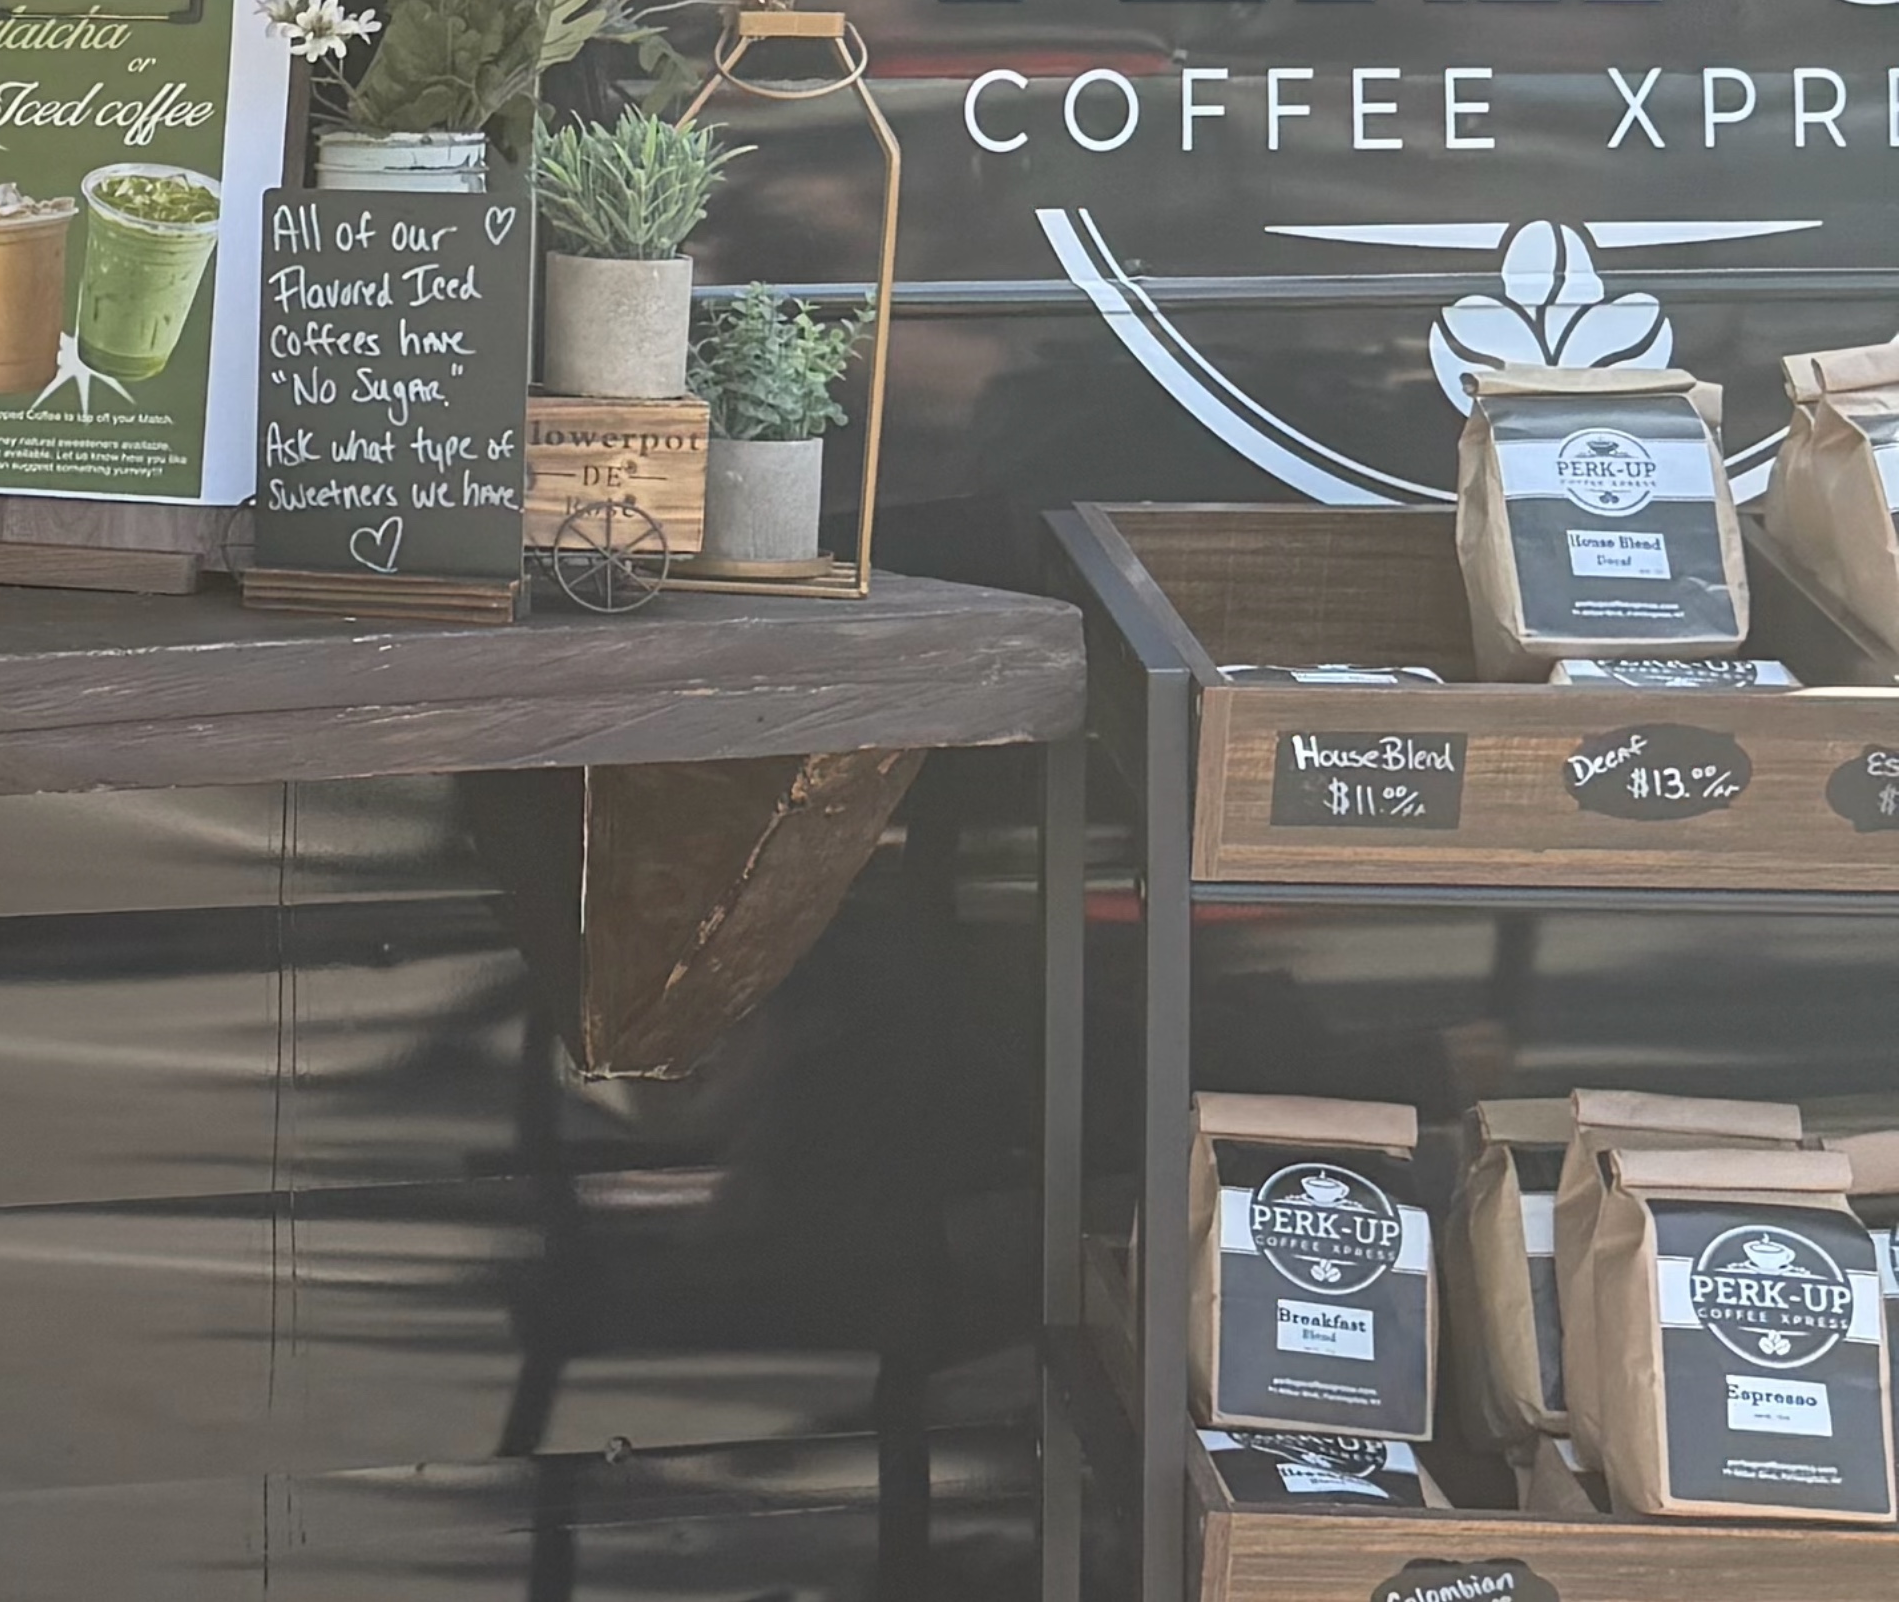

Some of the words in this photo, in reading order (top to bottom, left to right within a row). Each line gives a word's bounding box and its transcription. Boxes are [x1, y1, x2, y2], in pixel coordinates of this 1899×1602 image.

[128, 55, 157, 73] or
[96, 82, 215, 146] coffee
[963, 67, 1496, 152] COFFEE
[1606, 67, 1899, 152] XPR
[273, 203, 321, 254] All
[335, 211, 376, 252] of
[391, 220, 458, 252] our
[269, 264, 393, 314] Flavored
[402, 264, 482, 308] Iced
[265, 421, 321, 469] Ask
[331, 430, 396, 465] what
[410, 426, 479, 474] type
[487, 430, 515, 460] of
[583, 465, 622, 487] DE
[1557, 461, 1656, 478] PERK-UP
[1619, 536, 1661, 550] Blend
[1252, 1204, 1400, 1246] PERK-UP
[1255, 1235, 1319, 1252] COFFEE
[1692, 1275, 1851, 1314] PERK-UP
[1279, 1308, 1367, 1333] Breakfast
[1697, 1307, 1767, 1323] COFFEE
[1781, 1314, 1849, 1330] XPRESS
[1727, 1384, 1818, 1407] Espresso
